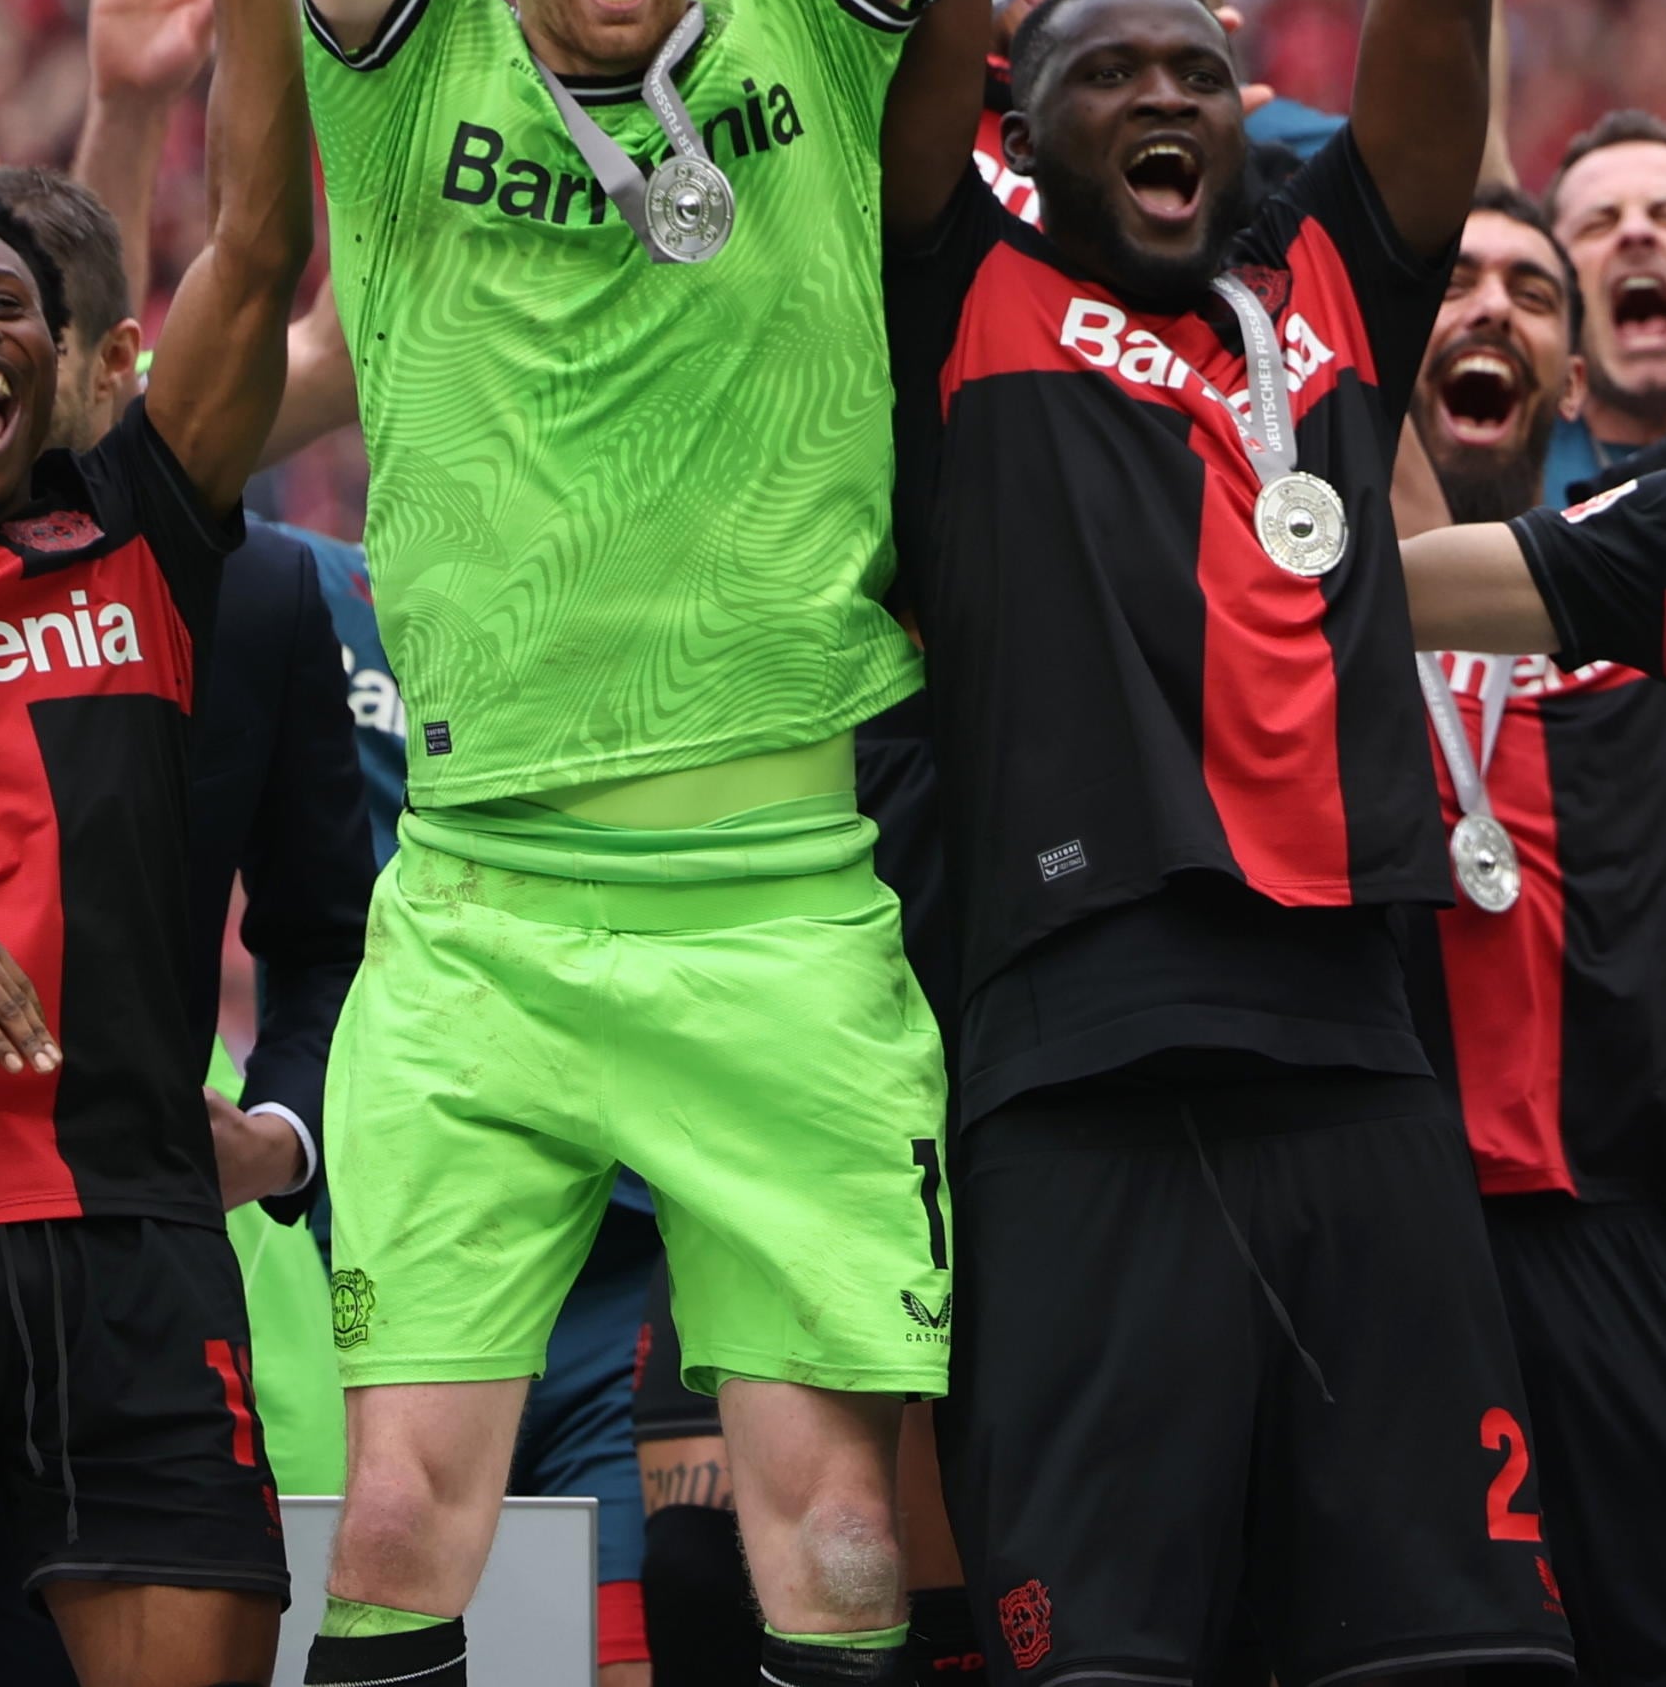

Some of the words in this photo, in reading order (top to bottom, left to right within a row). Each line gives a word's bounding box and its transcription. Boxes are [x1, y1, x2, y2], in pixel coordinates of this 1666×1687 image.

[910, 1138, 948, 1270] 1
[204, 1339, 257, 1467] 1
[1480, 1407, 1541, 1542] 2
